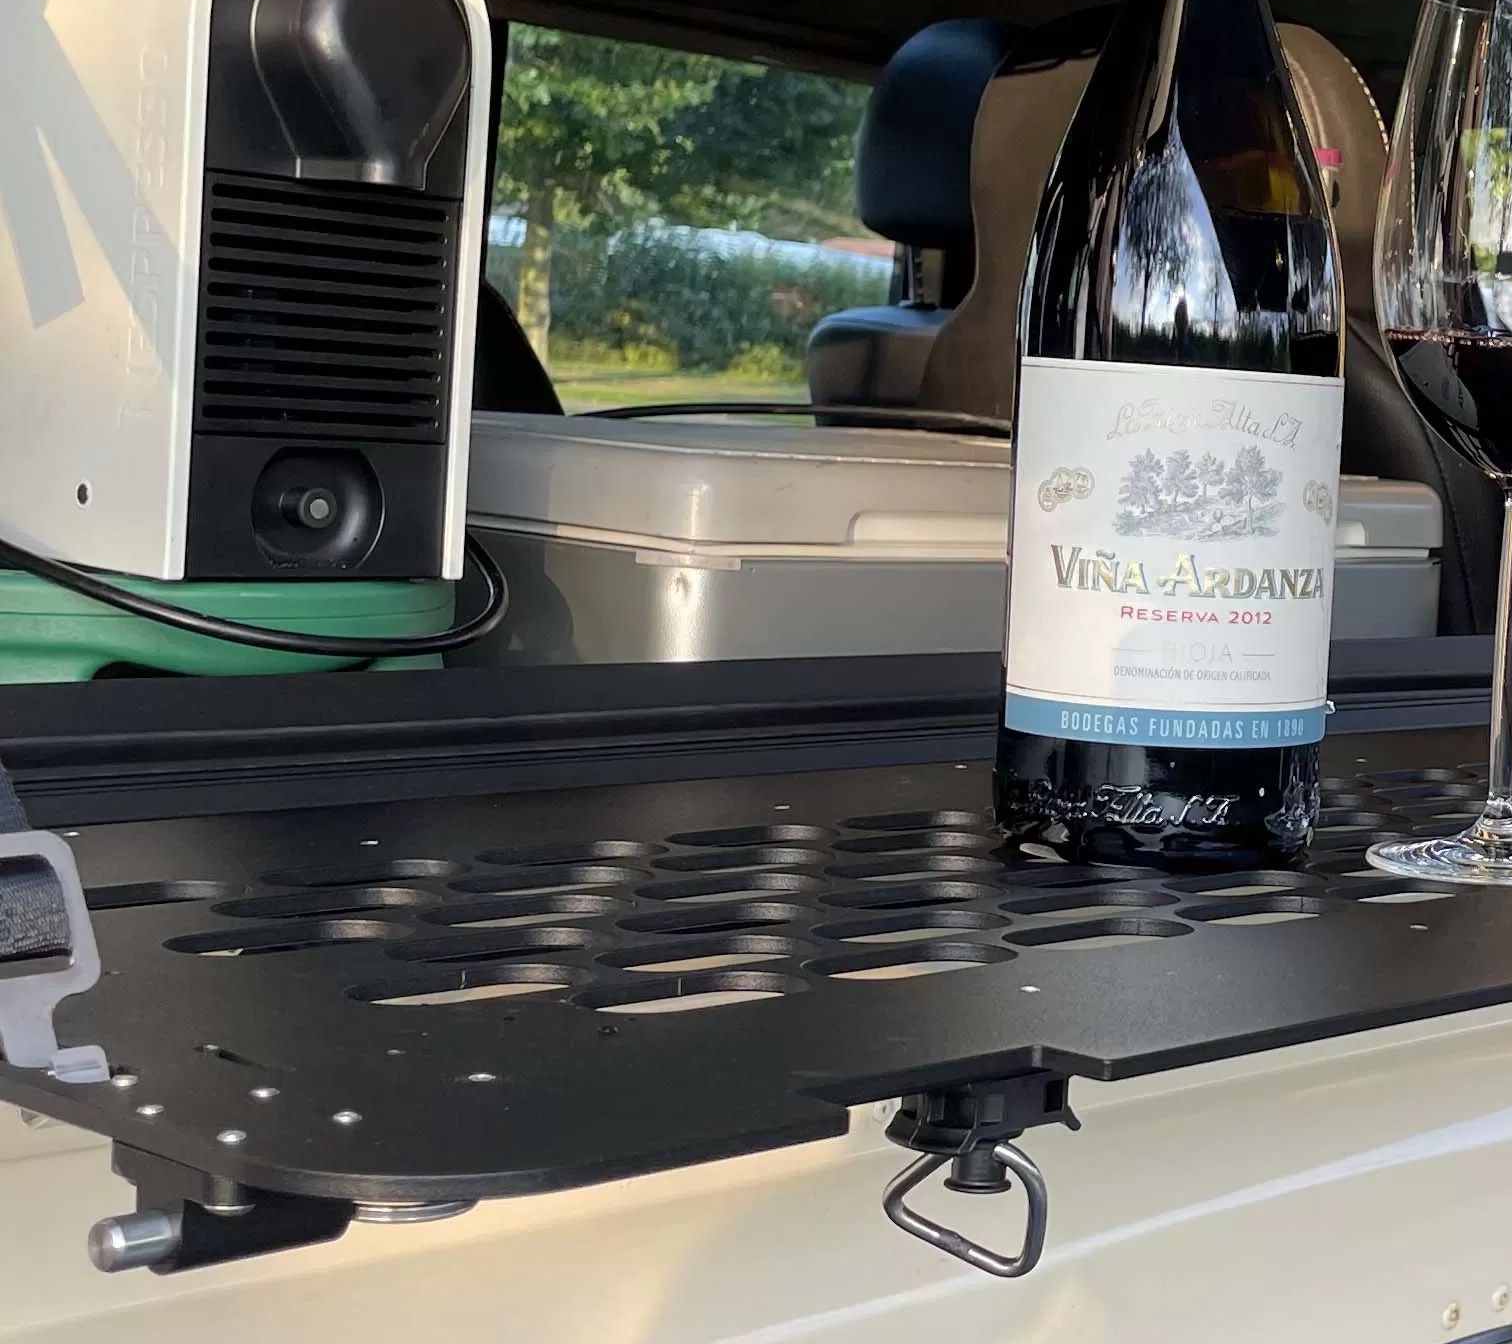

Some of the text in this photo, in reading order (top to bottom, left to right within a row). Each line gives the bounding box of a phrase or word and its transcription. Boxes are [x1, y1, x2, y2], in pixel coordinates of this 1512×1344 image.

[1051, 544, 1325, 600] VIÑA ARDANZA
[1120, 606, 1272, 625] RESERVA 2012
[1060, 710, 1139, 737] BODEGAS
[1149, 717, 1244, 740] FUNDADAS
[1252, 719, 1269, 739] EN
